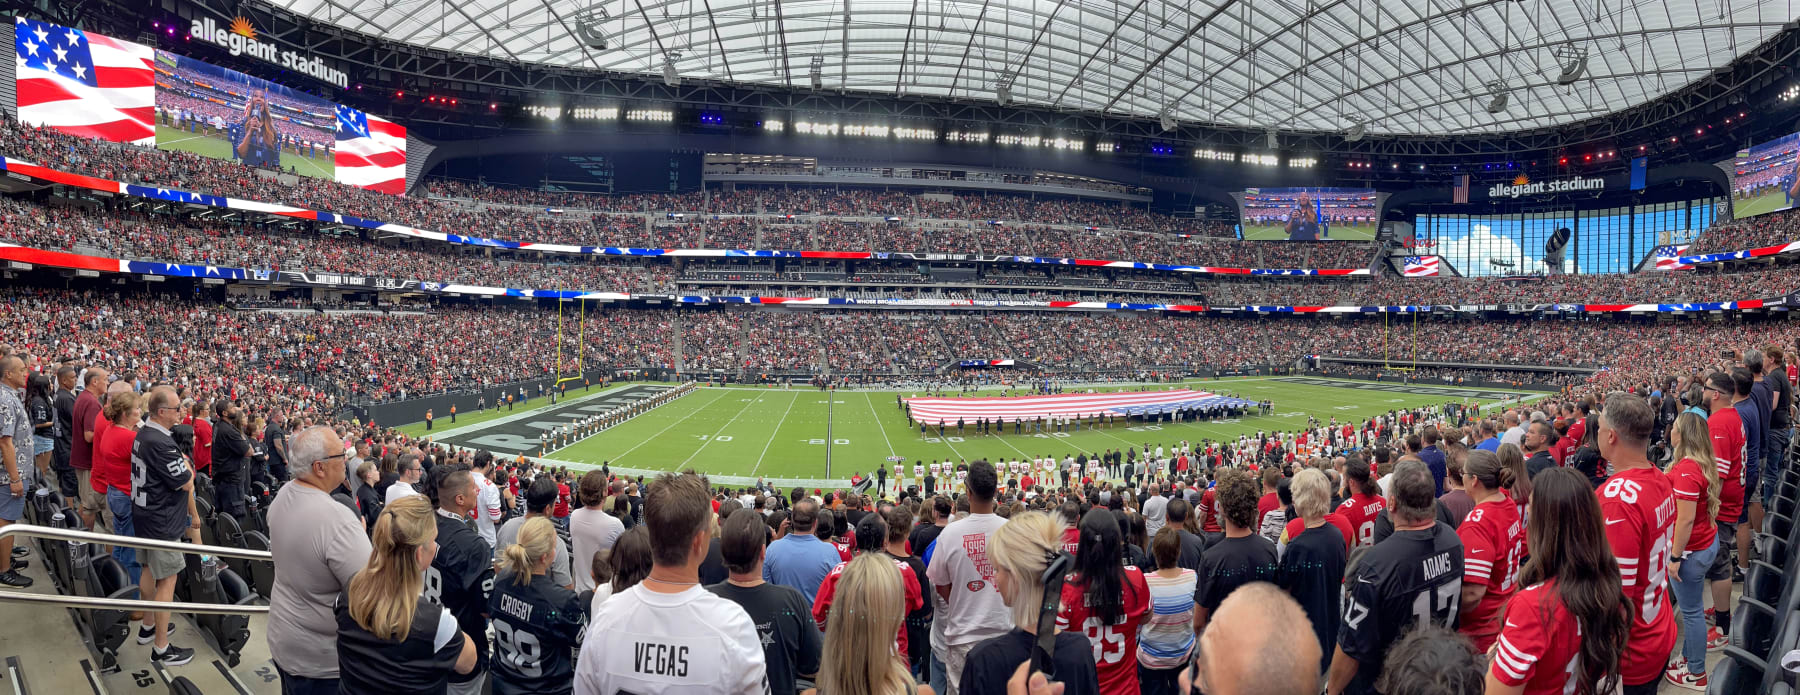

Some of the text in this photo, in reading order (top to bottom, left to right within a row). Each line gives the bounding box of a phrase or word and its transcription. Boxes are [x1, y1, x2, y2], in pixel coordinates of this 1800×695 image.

[190, 16, 348, 89] allegiant stadium
[1488, 175, 1604, 199] allegiant stadium
[1402, 234, 1436, 249] Coors
[37, 410, 47, 420] 13
[1603, 477, 1642, 504] 85
[1363, 501, 1383, 516] DAVIS
[1464, 508, 1485, 523] 13
[1654, 493, 1676, 529] KITTL
[964, 540, 985, 554] 1946
[1422, 552, 1451, 581] ADAMS
[500, 593, 534, 622] CROSBY
[1344, 597, 1370, 631] 17
[1412, 576, 1462, 635] 17
[1082, 613, 1128, 665] 85
[634, 641, 689, 677] VEGAS
[131, 669, 156, 688] 25
